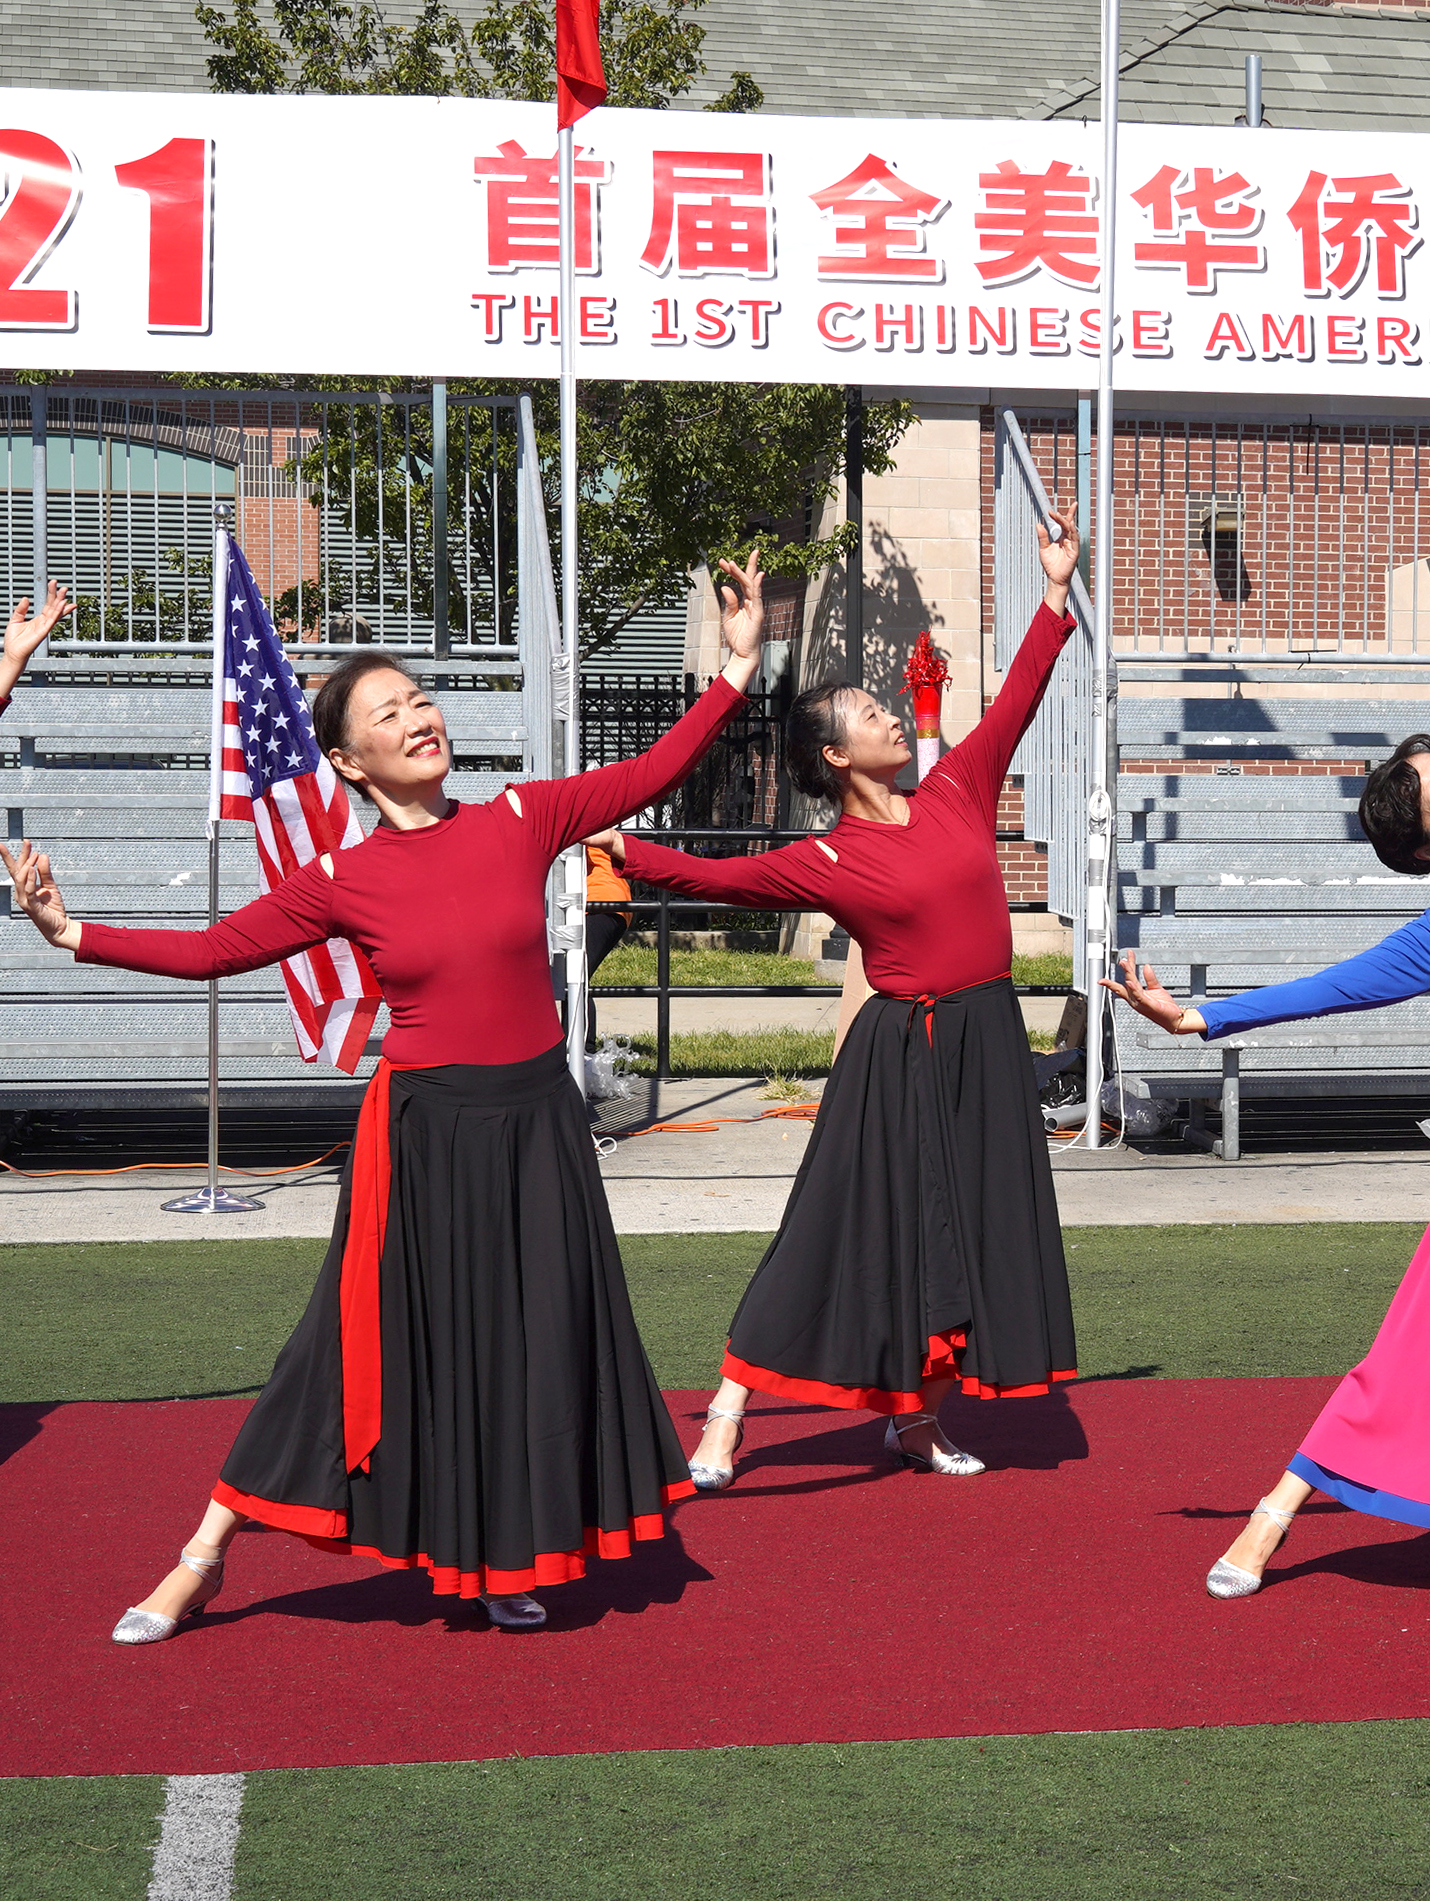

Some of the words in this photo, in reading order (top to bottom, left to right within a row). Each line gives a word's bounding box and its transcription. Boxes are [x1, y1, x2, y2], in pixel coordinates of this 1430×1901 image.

[470, 293, 617, 345] THE
[650, 298, 782, 350] 1ST
[817, 301, 1174, 360] CHINESE
